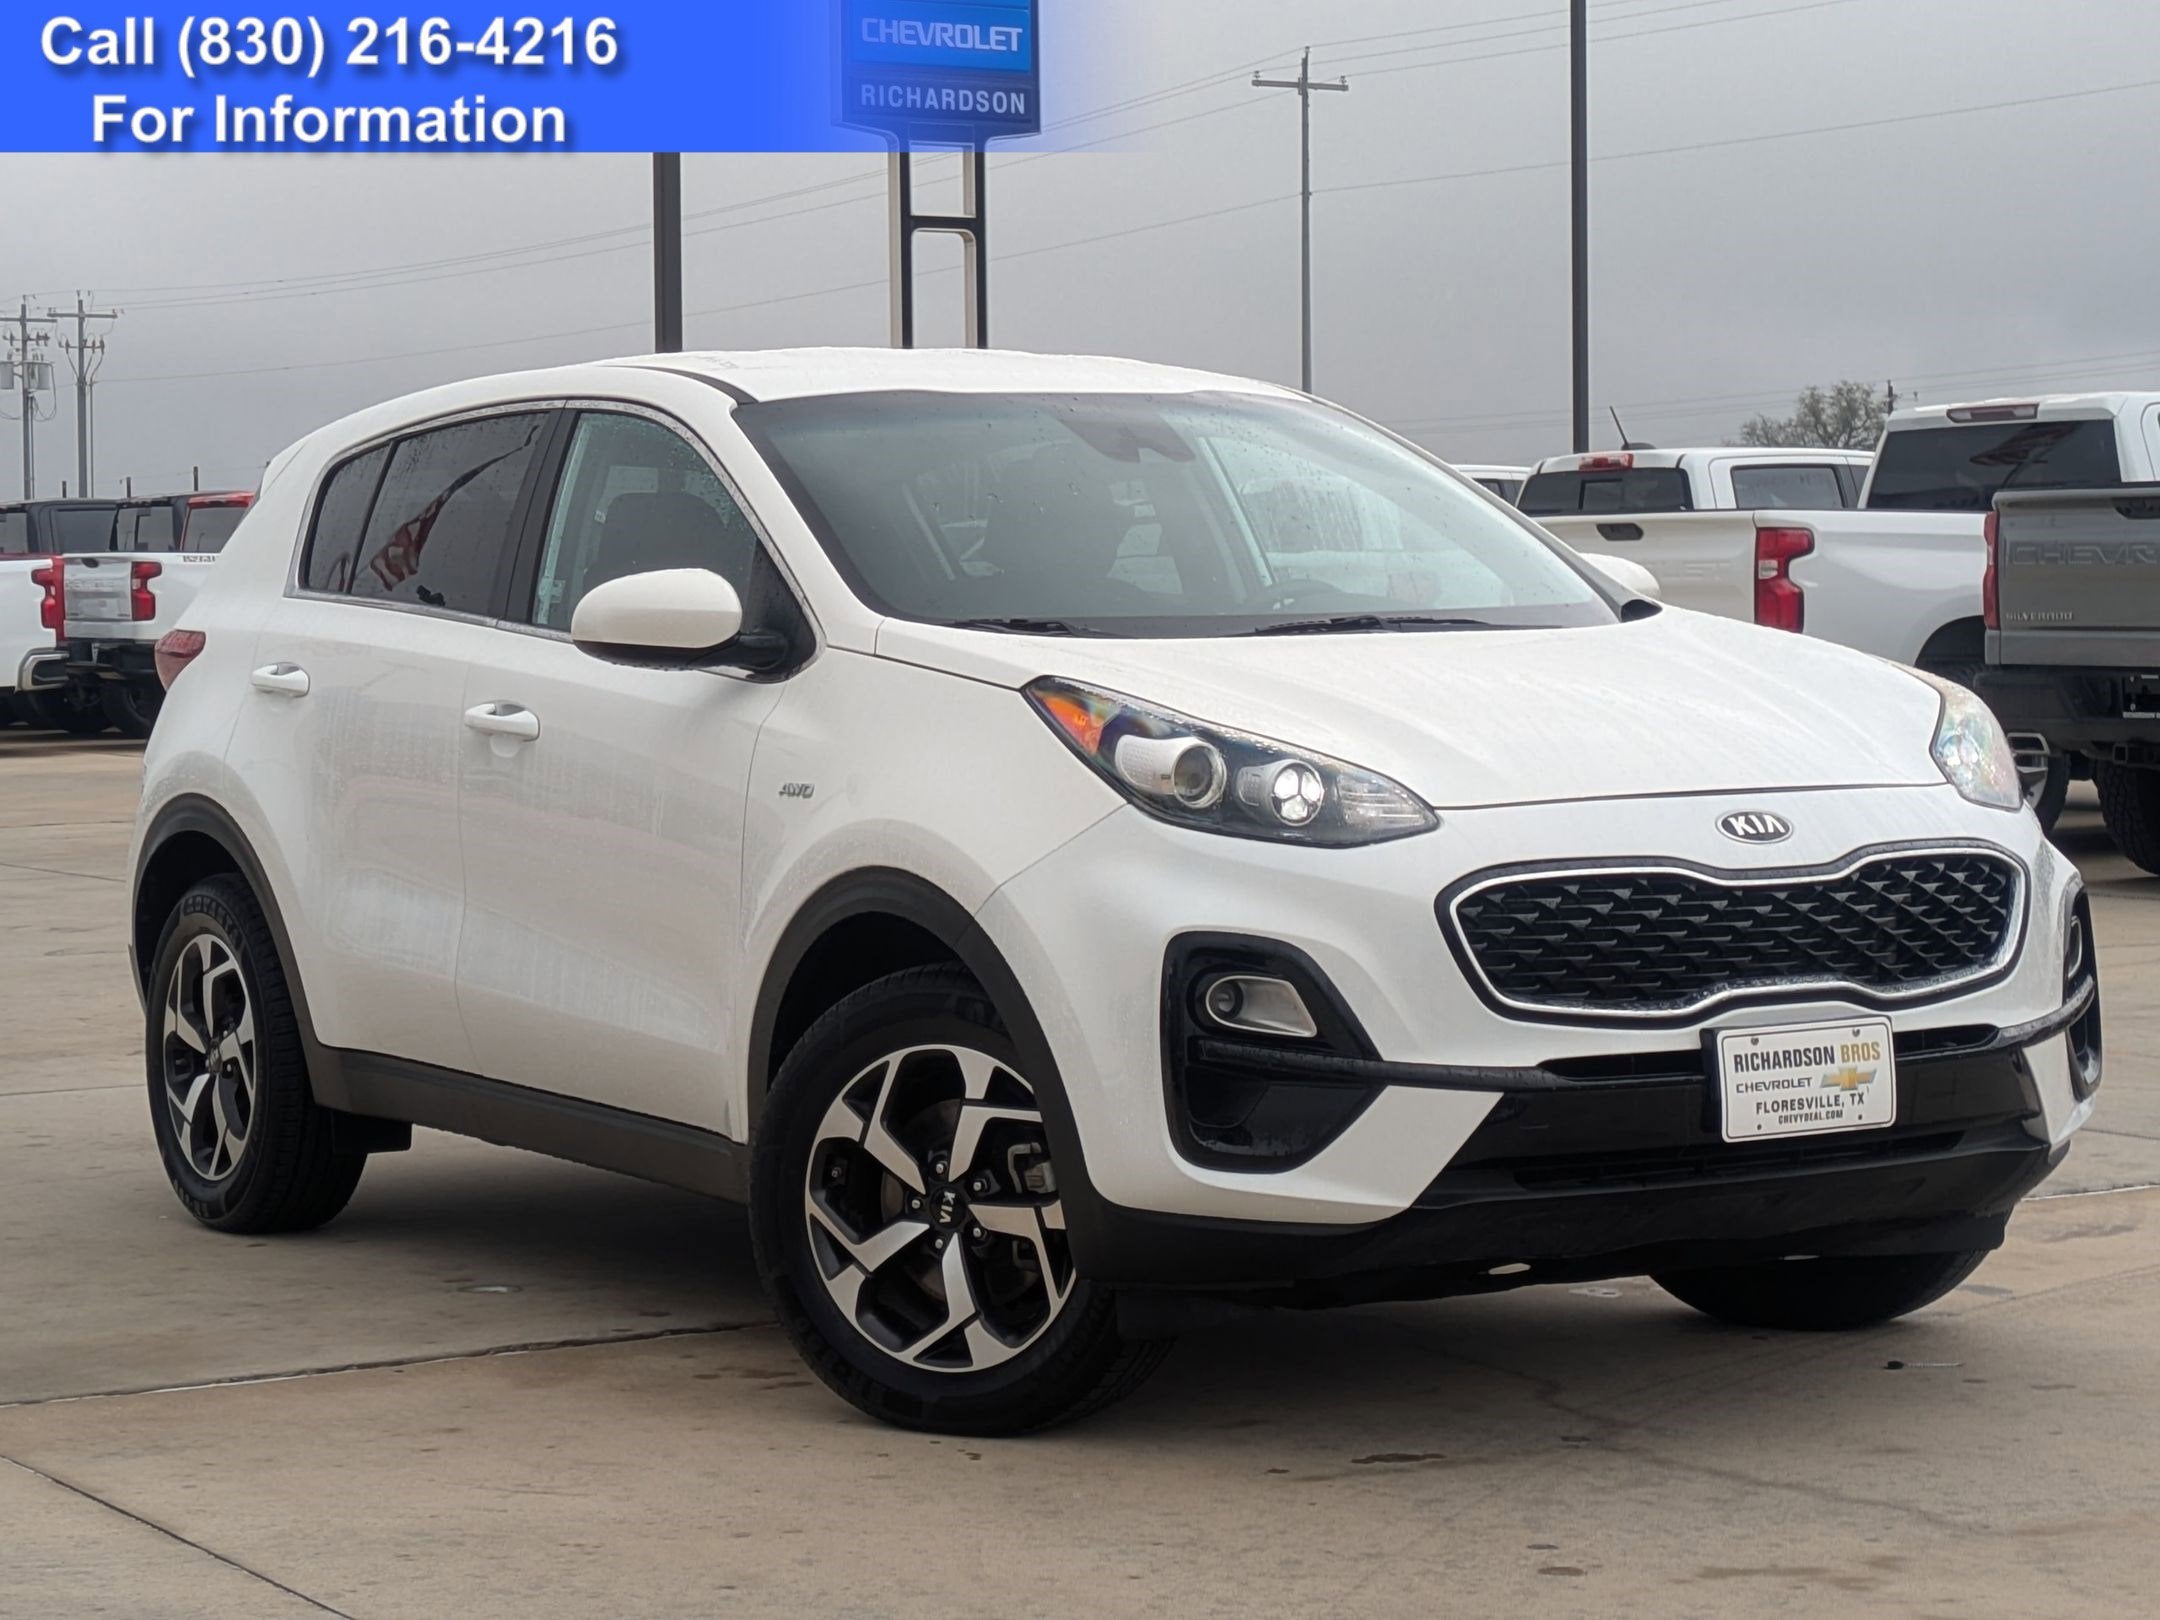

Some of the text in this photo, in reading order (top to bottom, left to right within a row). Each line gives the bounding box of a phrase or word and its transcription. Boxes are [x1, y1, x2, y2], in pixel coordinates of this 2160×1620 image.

[861, 17, 1024, 52] CHEVROLET
[860, 83, 1026, 115] RICHARDSON
[1727, 814, 1786, 836] KIA
[1733, 1041, 1882, 1074] RICHARDSON BROS
[1736, 1077, 1813, 1094] CHEVROLET
[1755, 1092, 1866, 1115] FLORESVILLE, TX
[1777, 1109, 1844, 1125] CHEVYDEAL.COM
[938, 1190, 957, 1224] KIA
